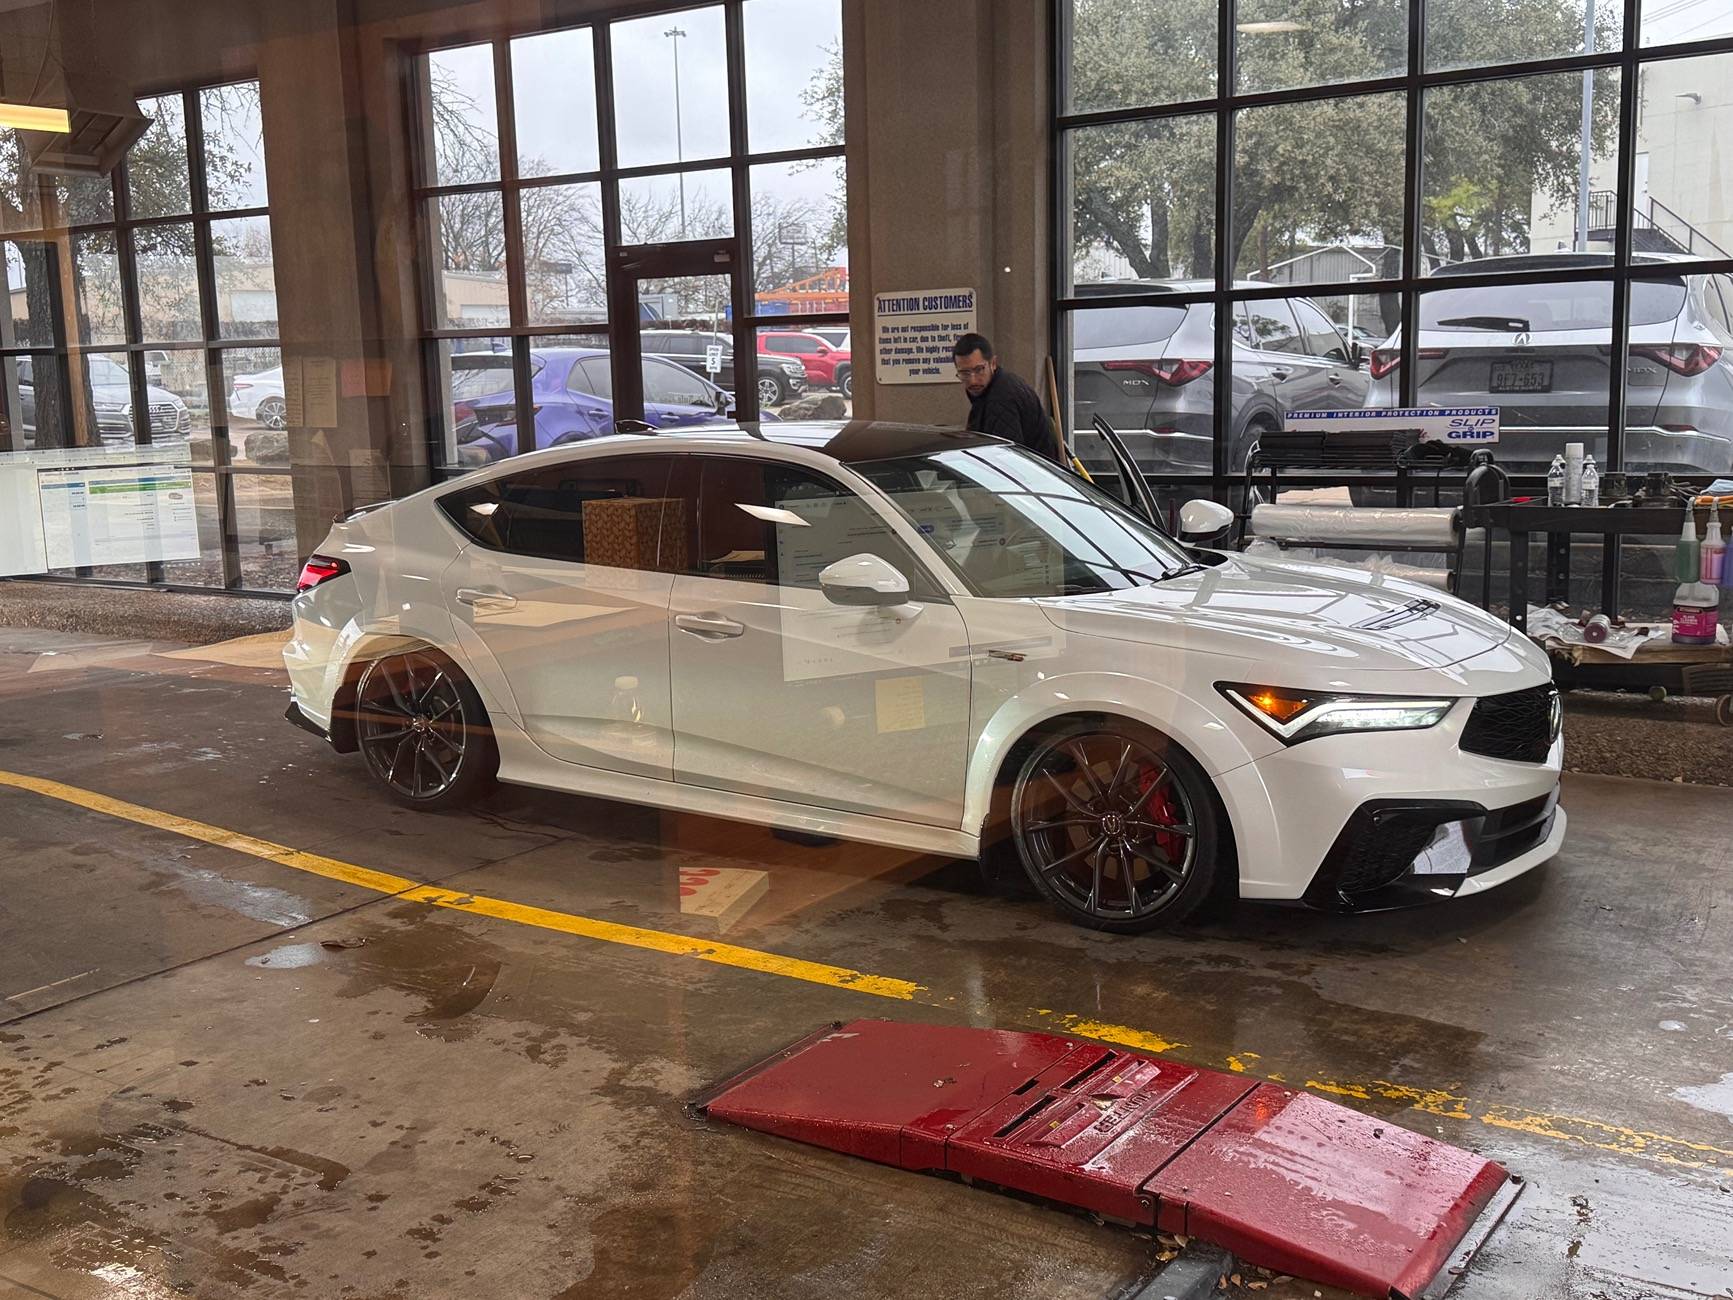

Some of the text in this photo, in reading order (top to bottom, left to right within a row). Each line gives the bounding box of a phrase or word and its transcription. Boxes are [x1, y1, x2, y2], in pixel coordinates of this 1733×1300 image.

[878, 295, 973, 313] ATTENTION CUSTOMERS
[910, 324, 939, 332] responsible
[941, 323, 950, 331] for
[951, 322, 961, 331] loss
[909, 336, 918, 344] car,
[920, 335, 929, 343] due
[1381, 410, 1440, 418] PROTECTION
[1445, 408, 1497, 416] PRODUCTS
[1449, 418, 1496, 428] SLIP
[1447, 431, 1495, 440] GRIP
